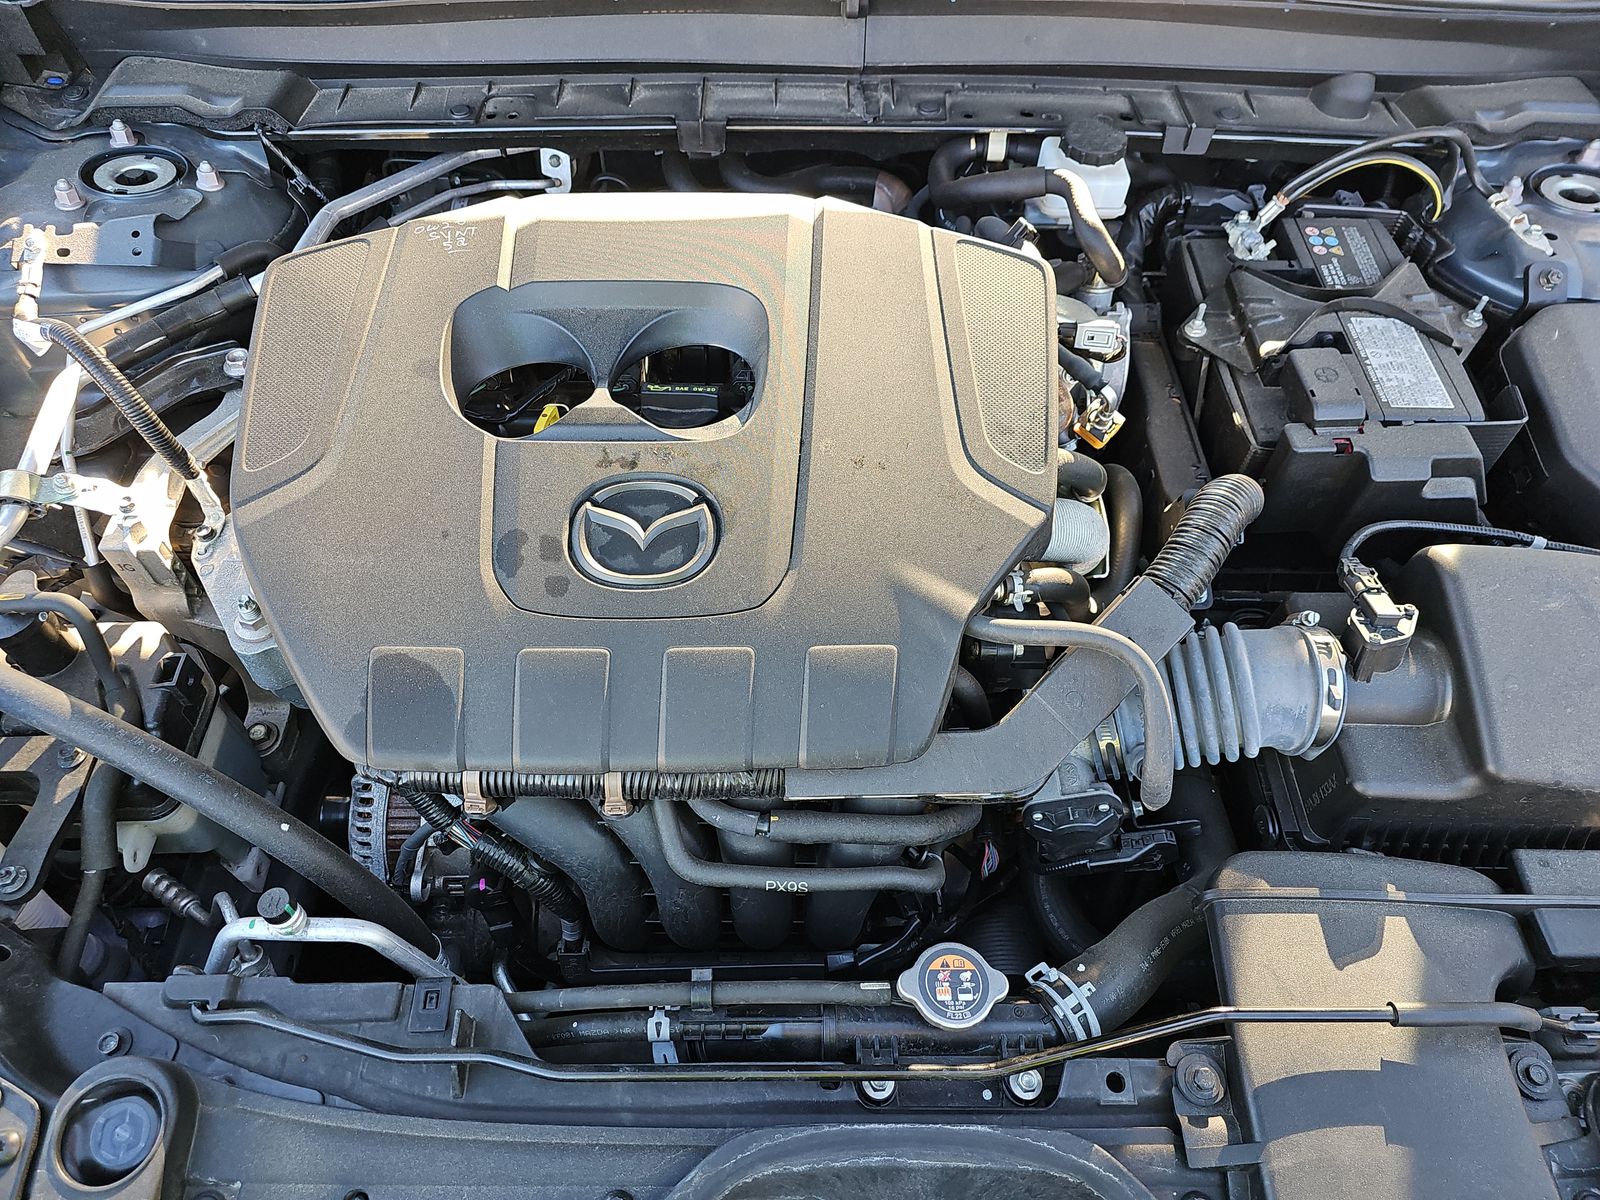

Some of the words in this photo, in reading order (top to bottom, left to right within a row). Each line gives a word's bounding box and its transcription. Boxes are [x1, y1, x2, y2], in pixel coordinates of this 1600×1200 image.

[765, 880, 808, 893] PX9S
[946, 1012, 963, 1020] FL22
[579, 1029, 610, 1037] MAZDA
